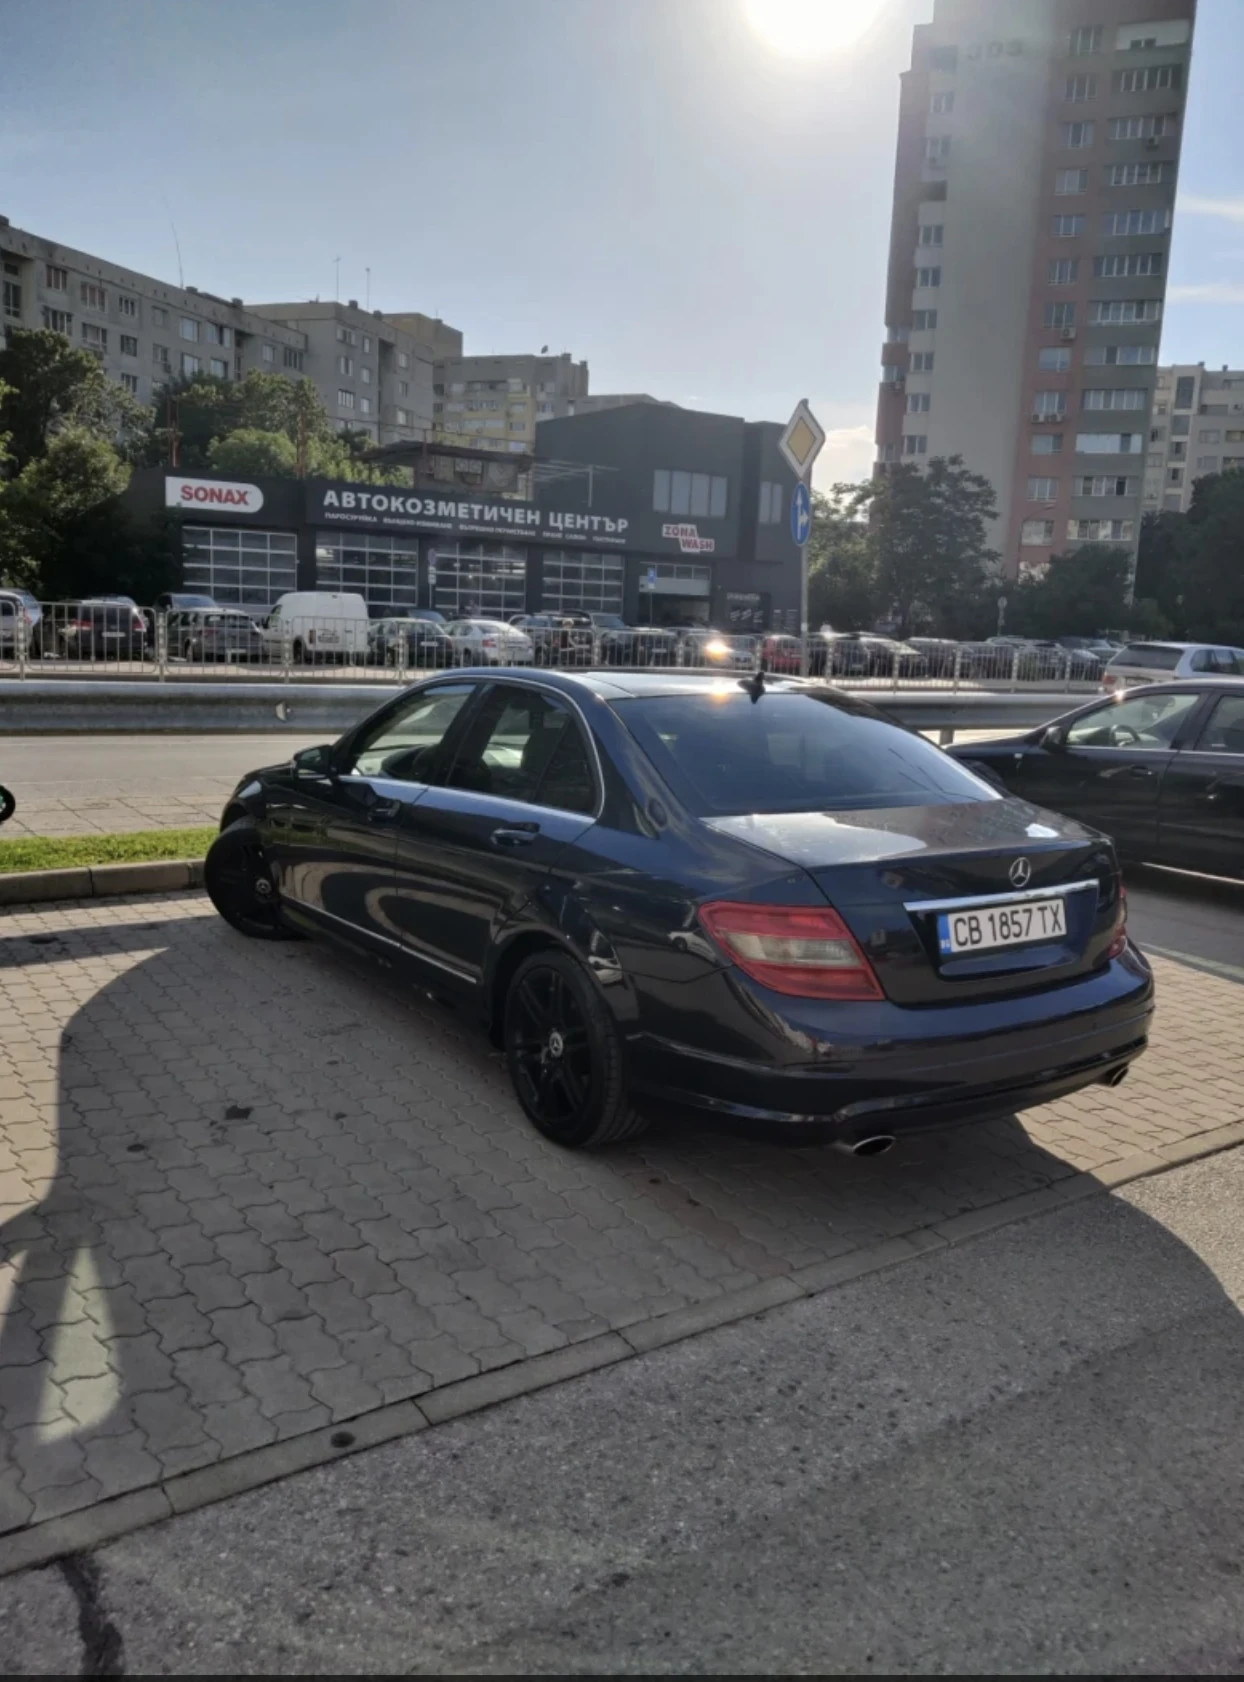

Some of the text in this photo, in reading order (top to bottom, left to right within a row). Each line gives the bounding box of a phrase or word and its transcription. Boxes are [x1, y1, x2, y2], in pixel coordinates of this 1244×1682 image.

[181, 485, 249, 506] SONAX
[323, 489, 629, 533] АВТОКОЗМЕТИЧЕН ЦЕНТЪР
[664, 525, 696, 537] ZONA
[681, 538, 713, 550] WASH
[954, 916, 982, 946] CB
[988, 908, 1033, 942] 1857
[1037, 903, 1062, 934] TX
